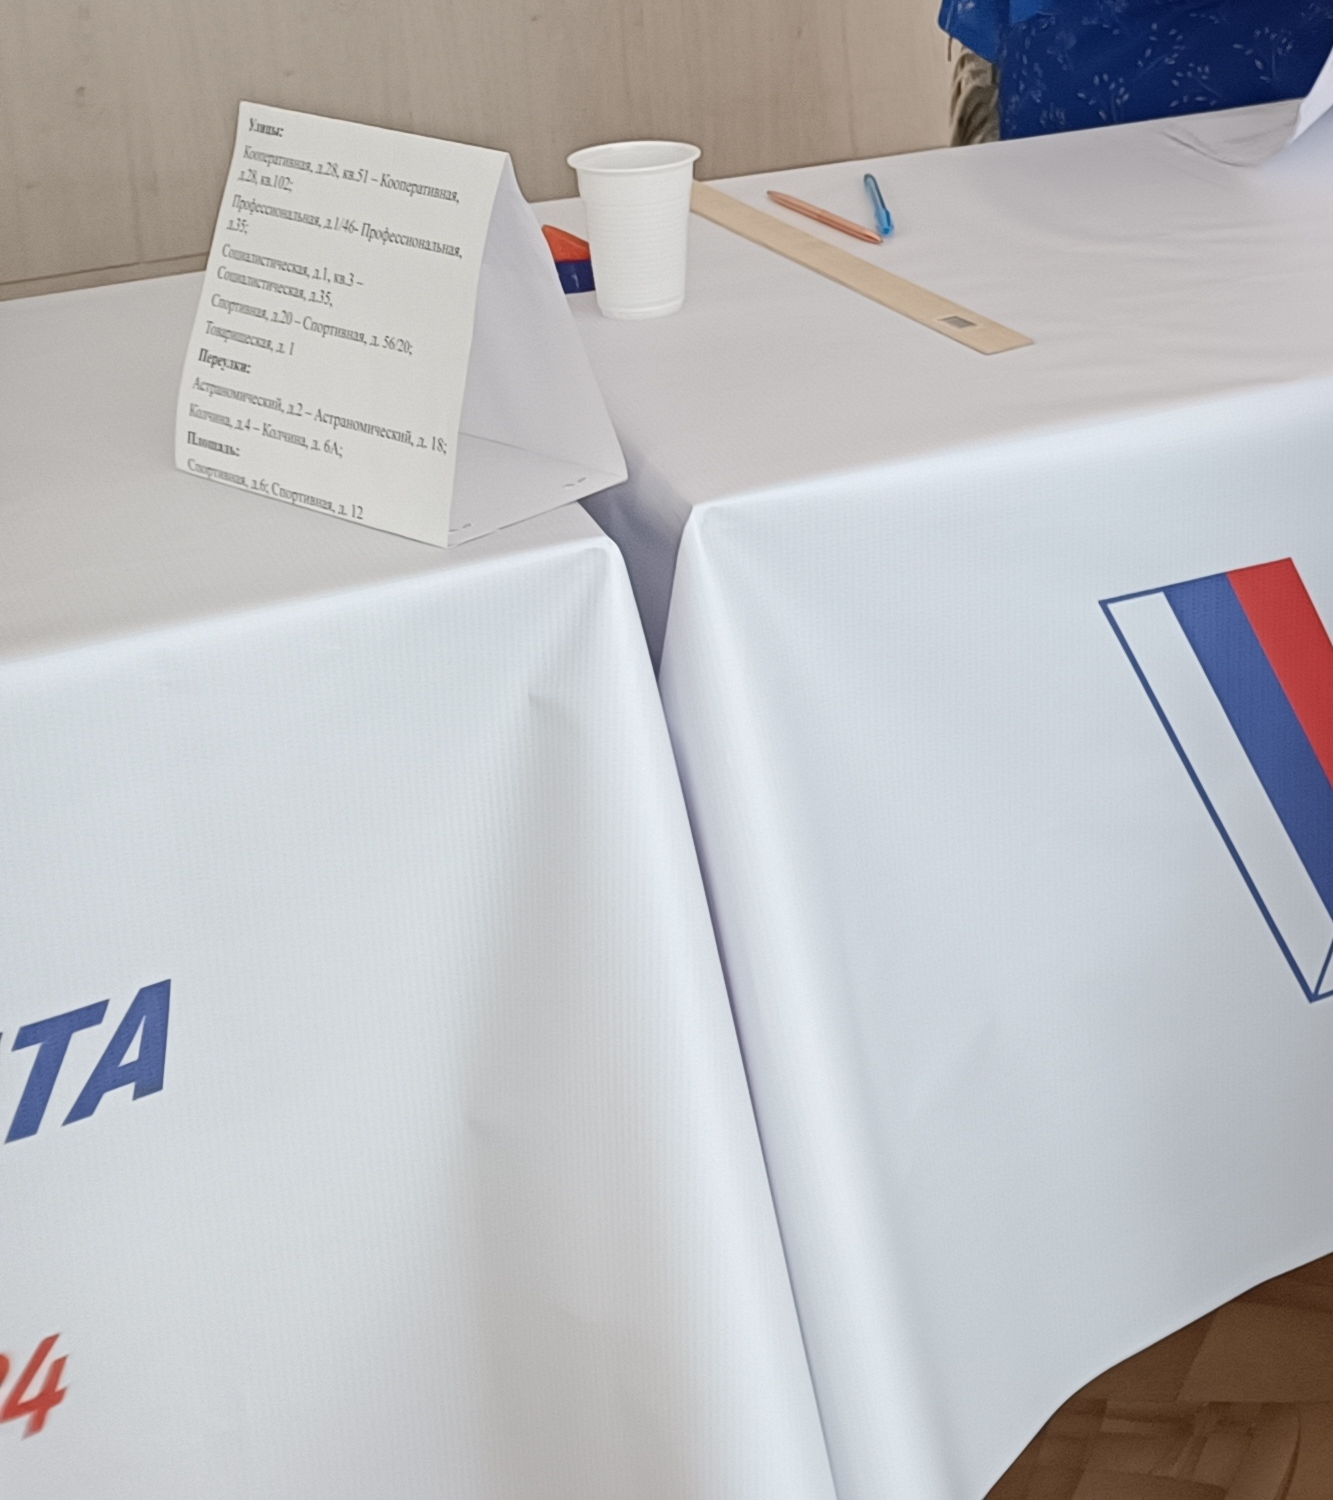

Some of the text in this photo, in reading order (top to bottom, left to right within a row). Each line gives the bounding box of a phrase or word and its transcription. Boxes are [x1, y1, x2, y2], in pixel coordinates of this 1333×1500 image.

[249, 118, 284, 137] Улицы:
[380, 173, 460, 204] Кооперативная,
[361, 222, 463, 259] Профессиональная,
[302, 316, 367, 345] Спортивная,
[198, 348, 251, 374] Переулки:
[314, 408, 414, 447] Астраномический,
[187, 431, 240, 457] Площадь:
